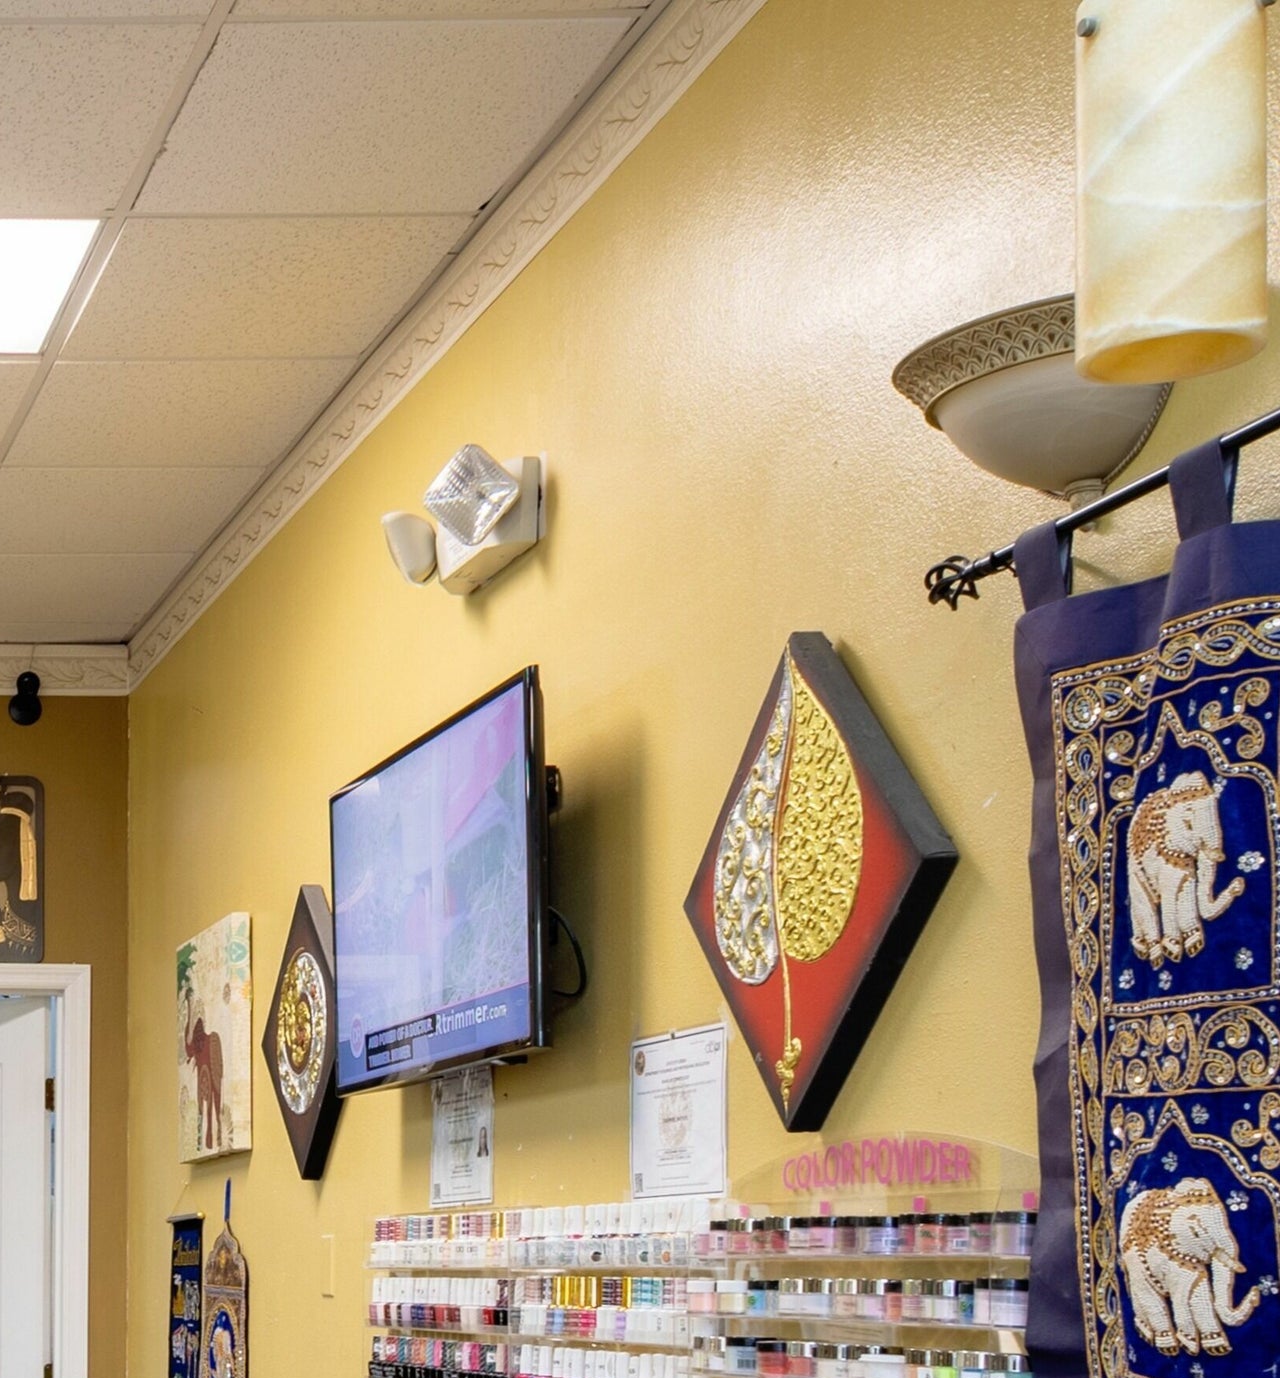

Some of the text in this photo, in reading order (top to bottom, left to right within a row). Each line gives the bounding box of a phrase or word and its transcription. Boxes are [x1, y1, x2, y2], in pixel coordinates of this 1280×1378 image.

[427, 1003, 507, 1037] Rtrimmer.com
[783, 1138, 971, 1190] COLOR POWDER
